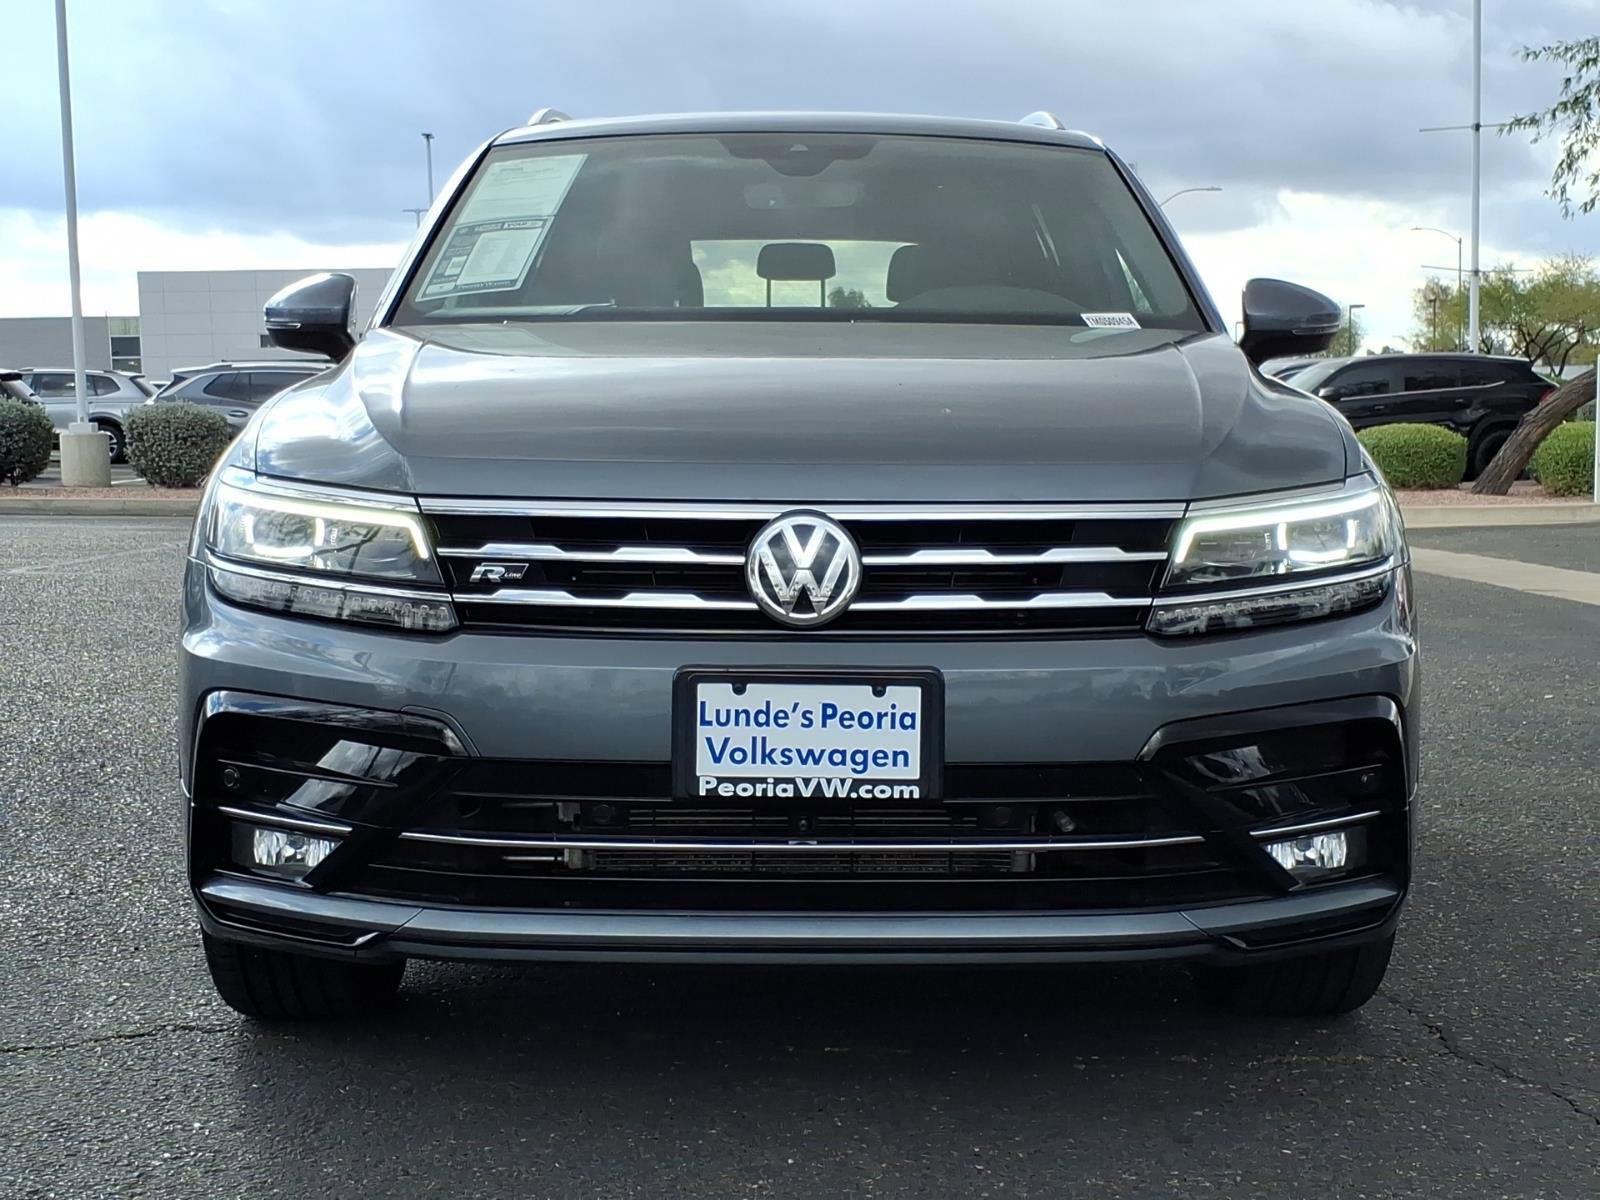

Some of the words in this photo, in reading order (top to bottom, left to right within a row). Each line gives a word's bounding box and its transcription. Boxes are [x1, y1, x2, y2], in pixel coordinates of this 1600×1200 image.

[470, 566, 506, 582] R
[699, 700, 814, 729] Lunde's
[820, 702, 917, 731] Peoria
[704, 736, 910, 774] Volkswagen
[699, 776, 920, 799] PeoriaVW.com
